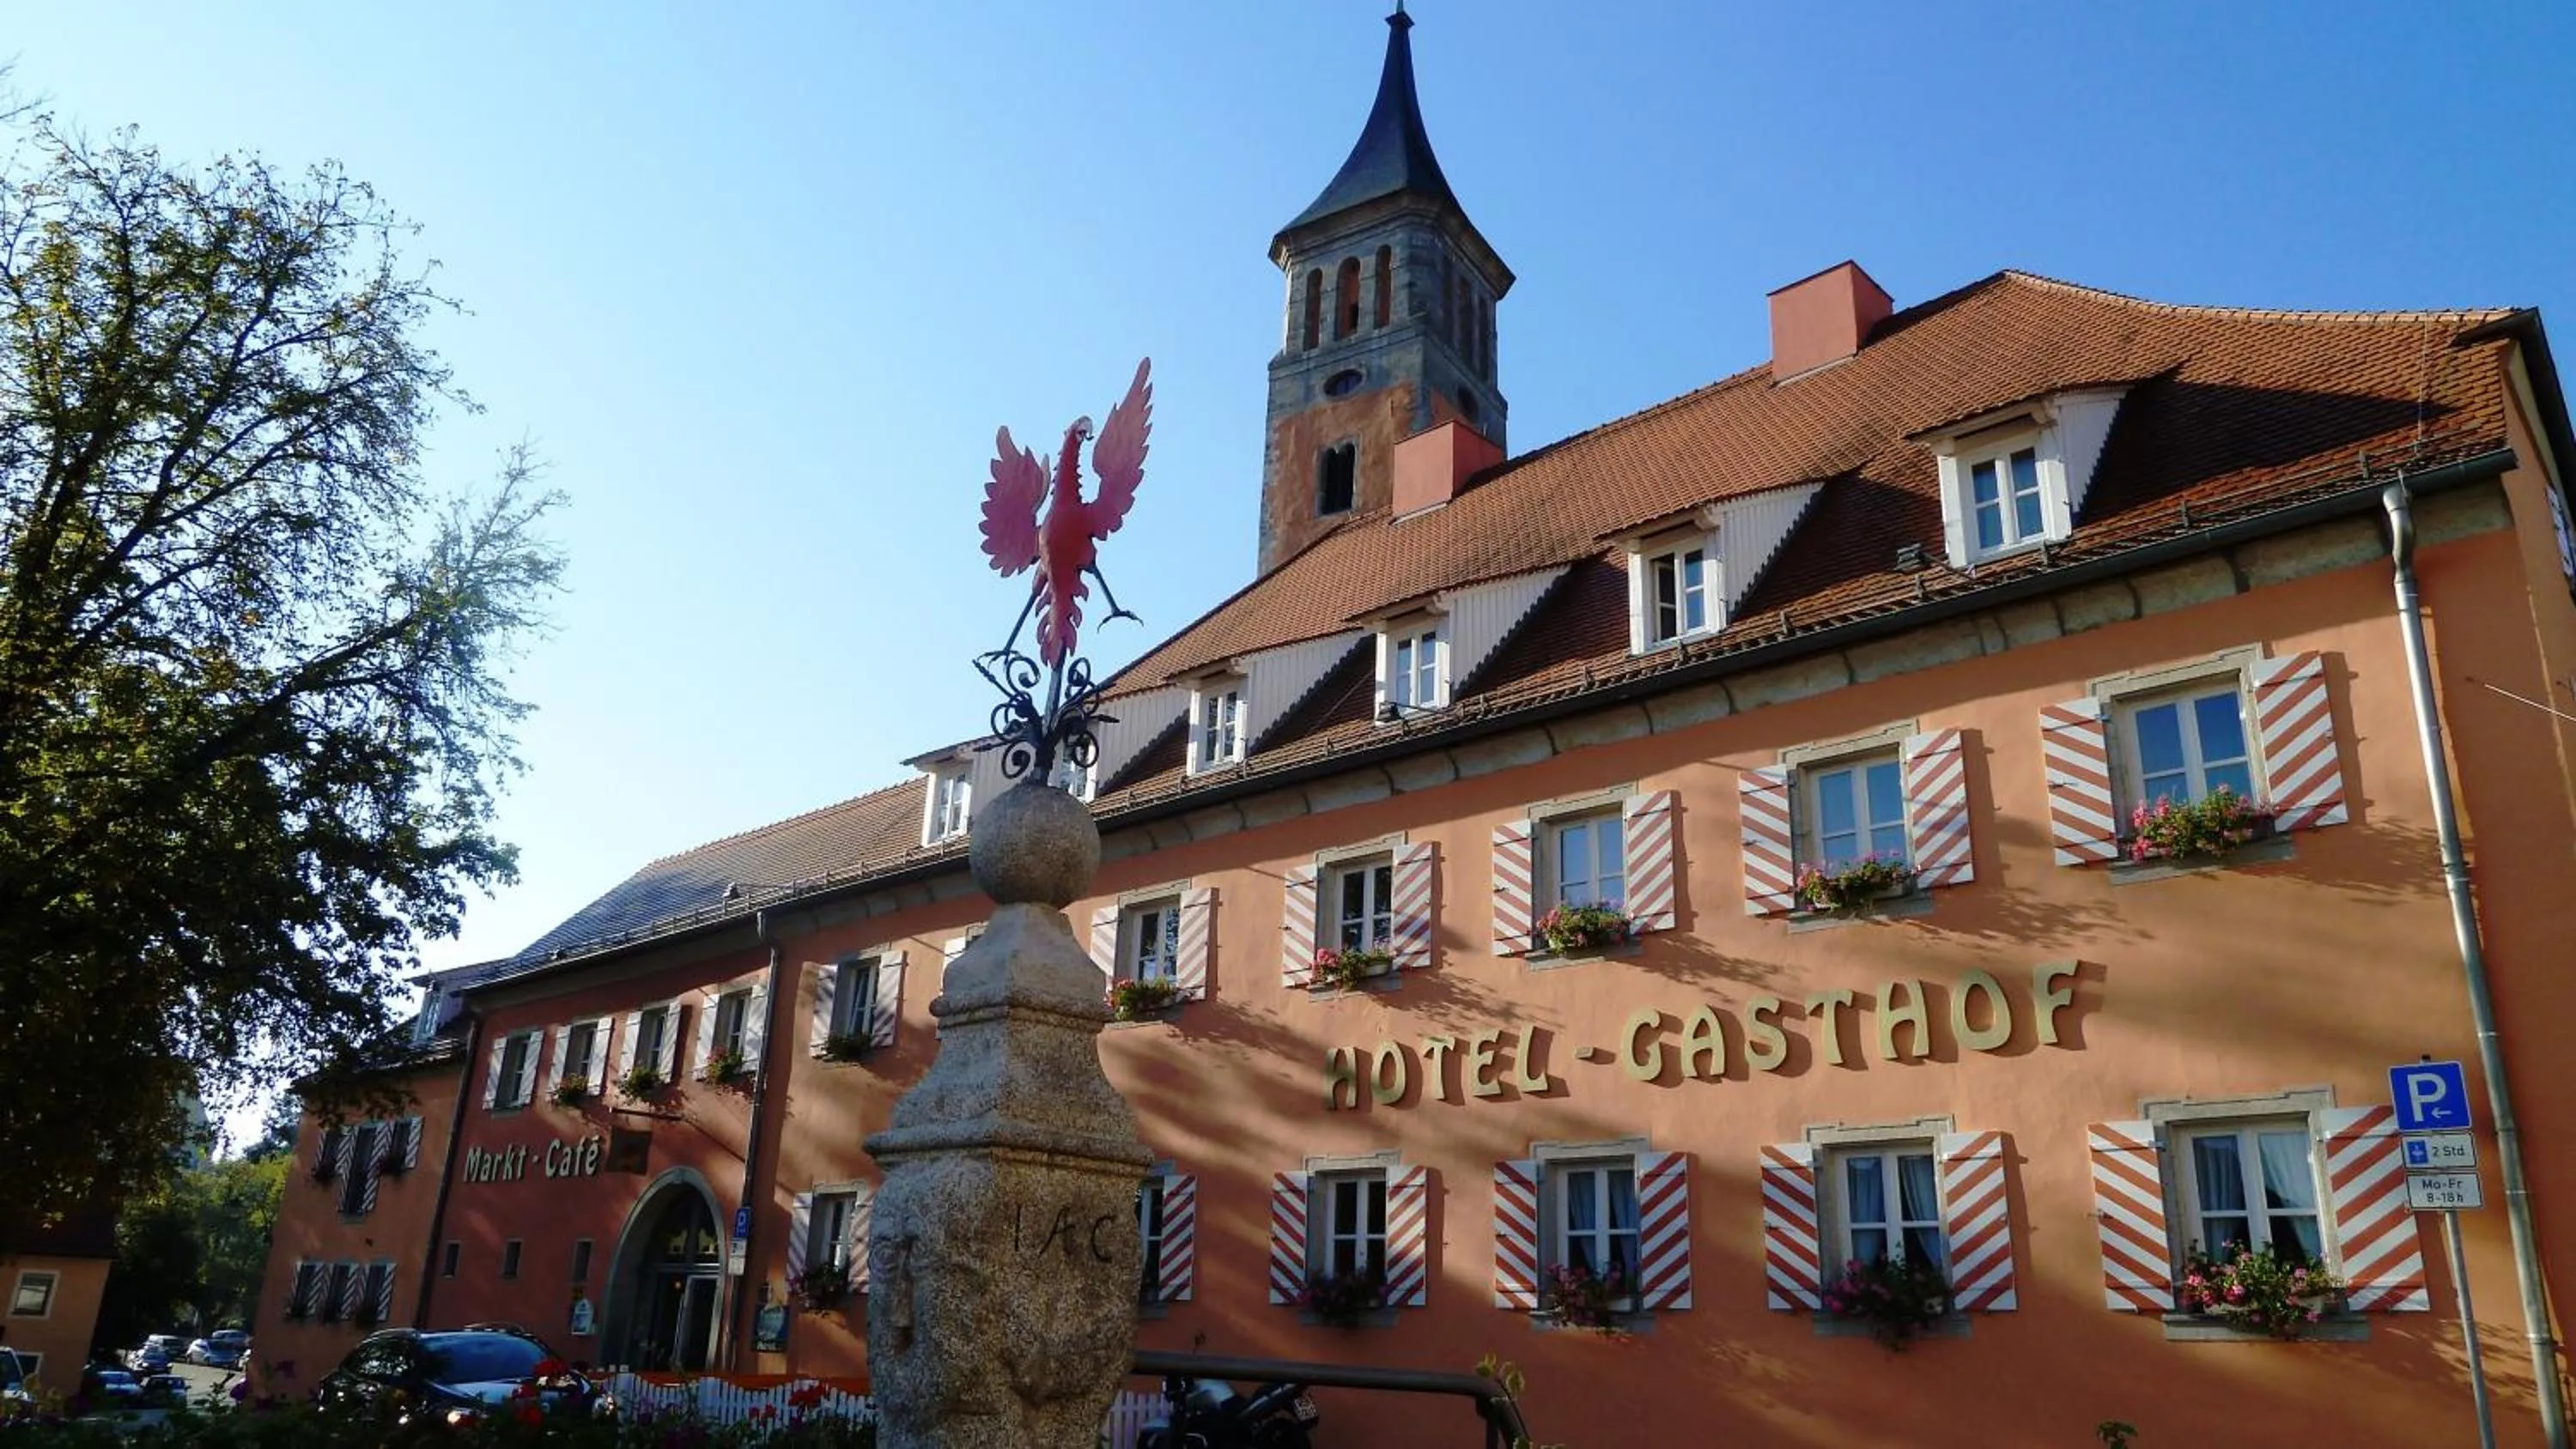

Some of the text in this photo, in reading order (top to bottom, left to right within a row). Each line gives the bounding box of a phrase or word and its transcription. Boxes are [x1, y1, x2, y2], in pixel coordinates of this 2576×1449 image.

[1322, 1024, 1548, 1111] HOTEL
[1619, 958, 2081, 1082] GASTHOF
[2407, 1072, 2446, 1122] P
[463, 1143, 527, 1182] Markt
[545, 1135, 600, 1178] Café
[2443, 1143, 2466, 1156] Std
